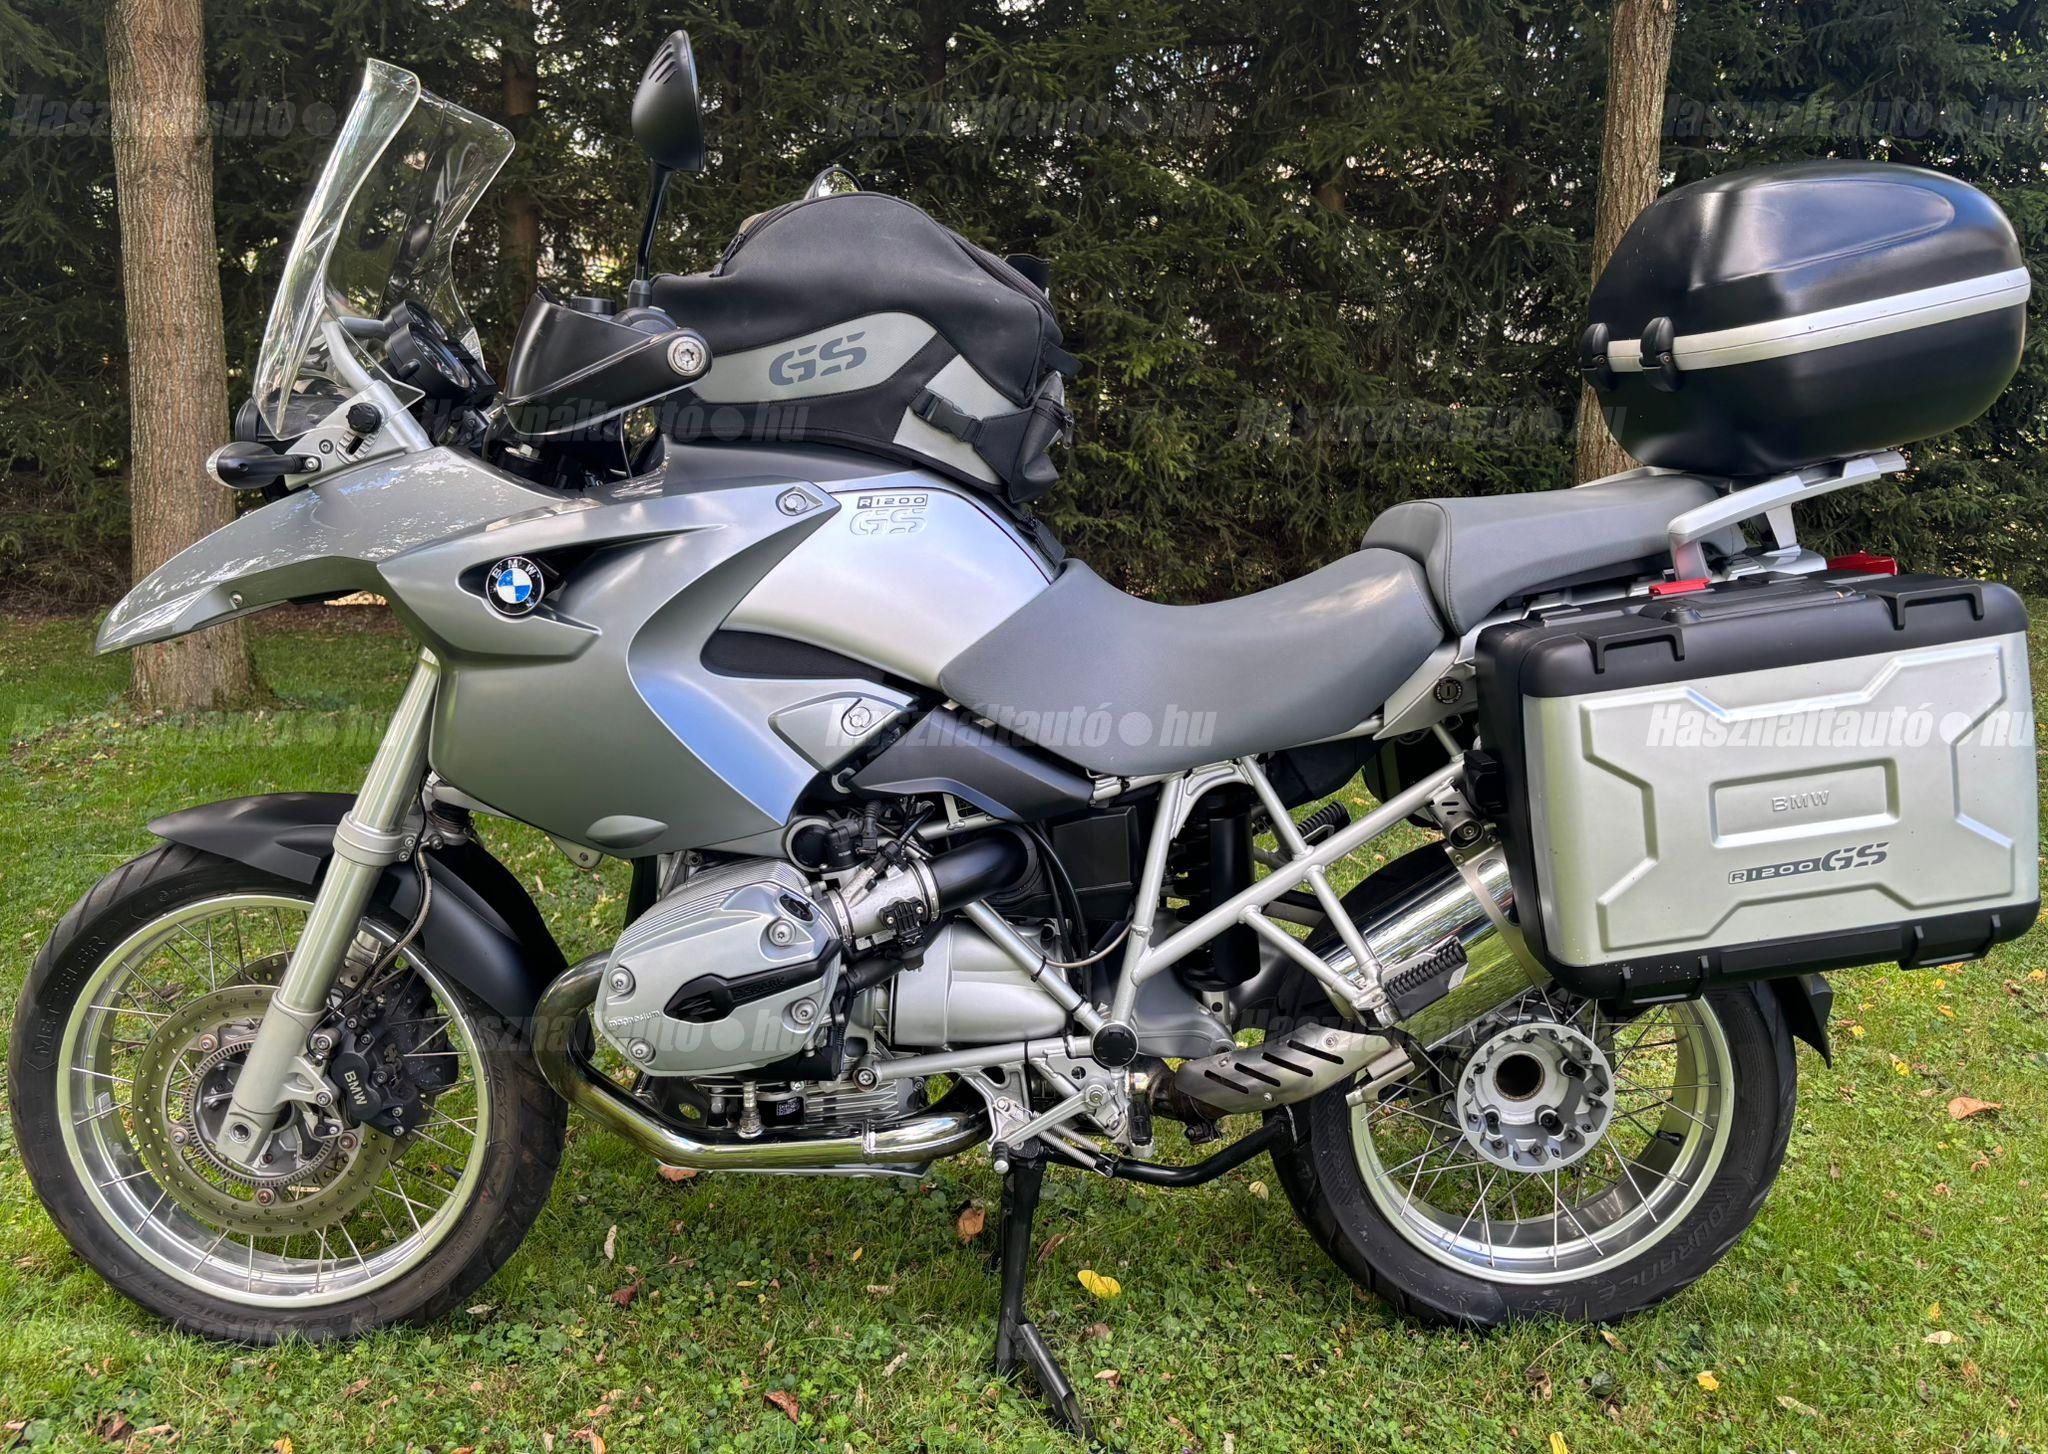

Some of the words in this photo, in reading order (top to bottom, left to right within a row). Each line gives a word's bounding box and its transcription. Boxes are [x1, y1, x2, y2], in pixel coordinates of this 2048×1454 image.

[769, 331, 867, 386] GS
[858, 494, 927, 509] R1200
[849, 507, 927, 535] GS
[491, 558, 537, 579] BMW
[1772, 789, 1830, 813] BMW
[344, 1070, 367, 1105] BMW
